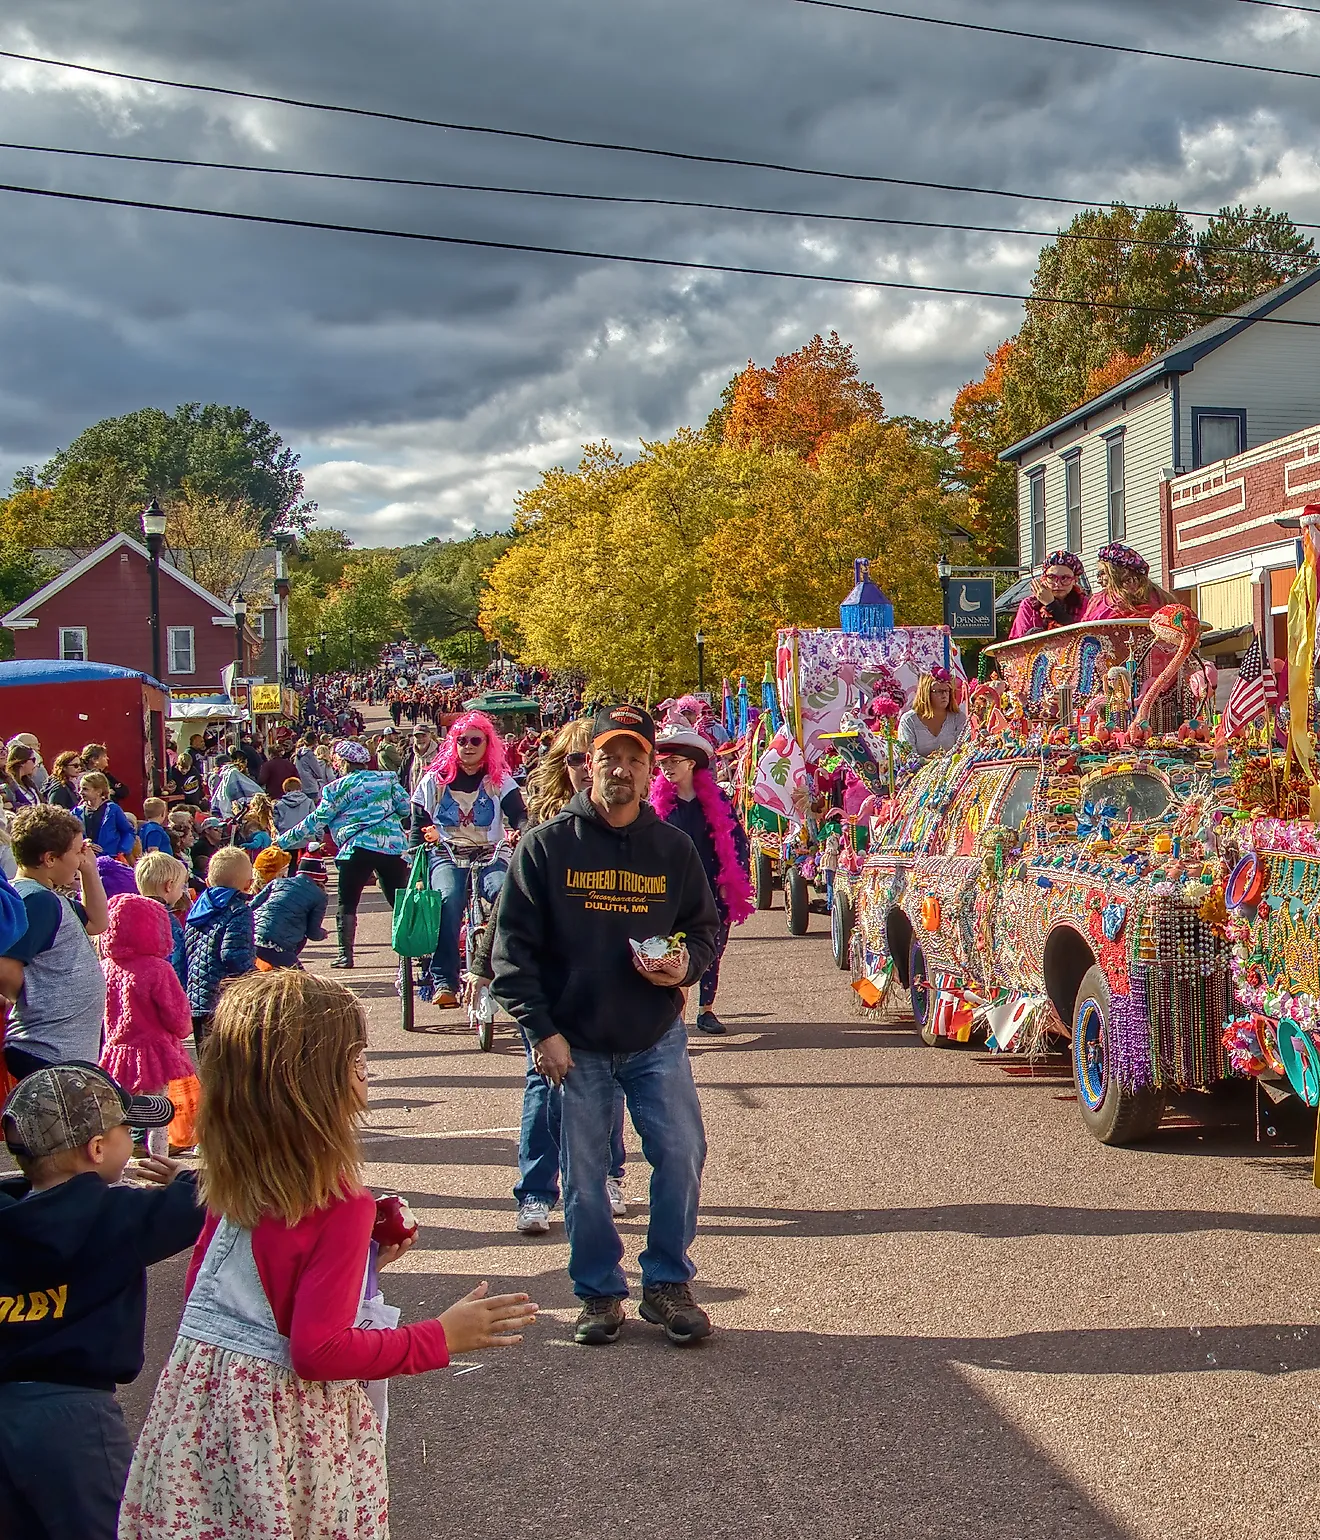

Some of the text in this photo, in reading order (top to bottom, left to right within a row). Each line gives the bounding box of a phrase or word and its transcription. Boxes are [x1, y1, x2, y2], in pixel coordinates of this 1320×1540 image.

[252, 700, 280, 711] Lemonade
[566, 868, 667, 894] LAKEHEAD TRUCKING
[587, 890, 647, 903] Incorporated
[584, 902, 648, 913] DULUTH, MN
